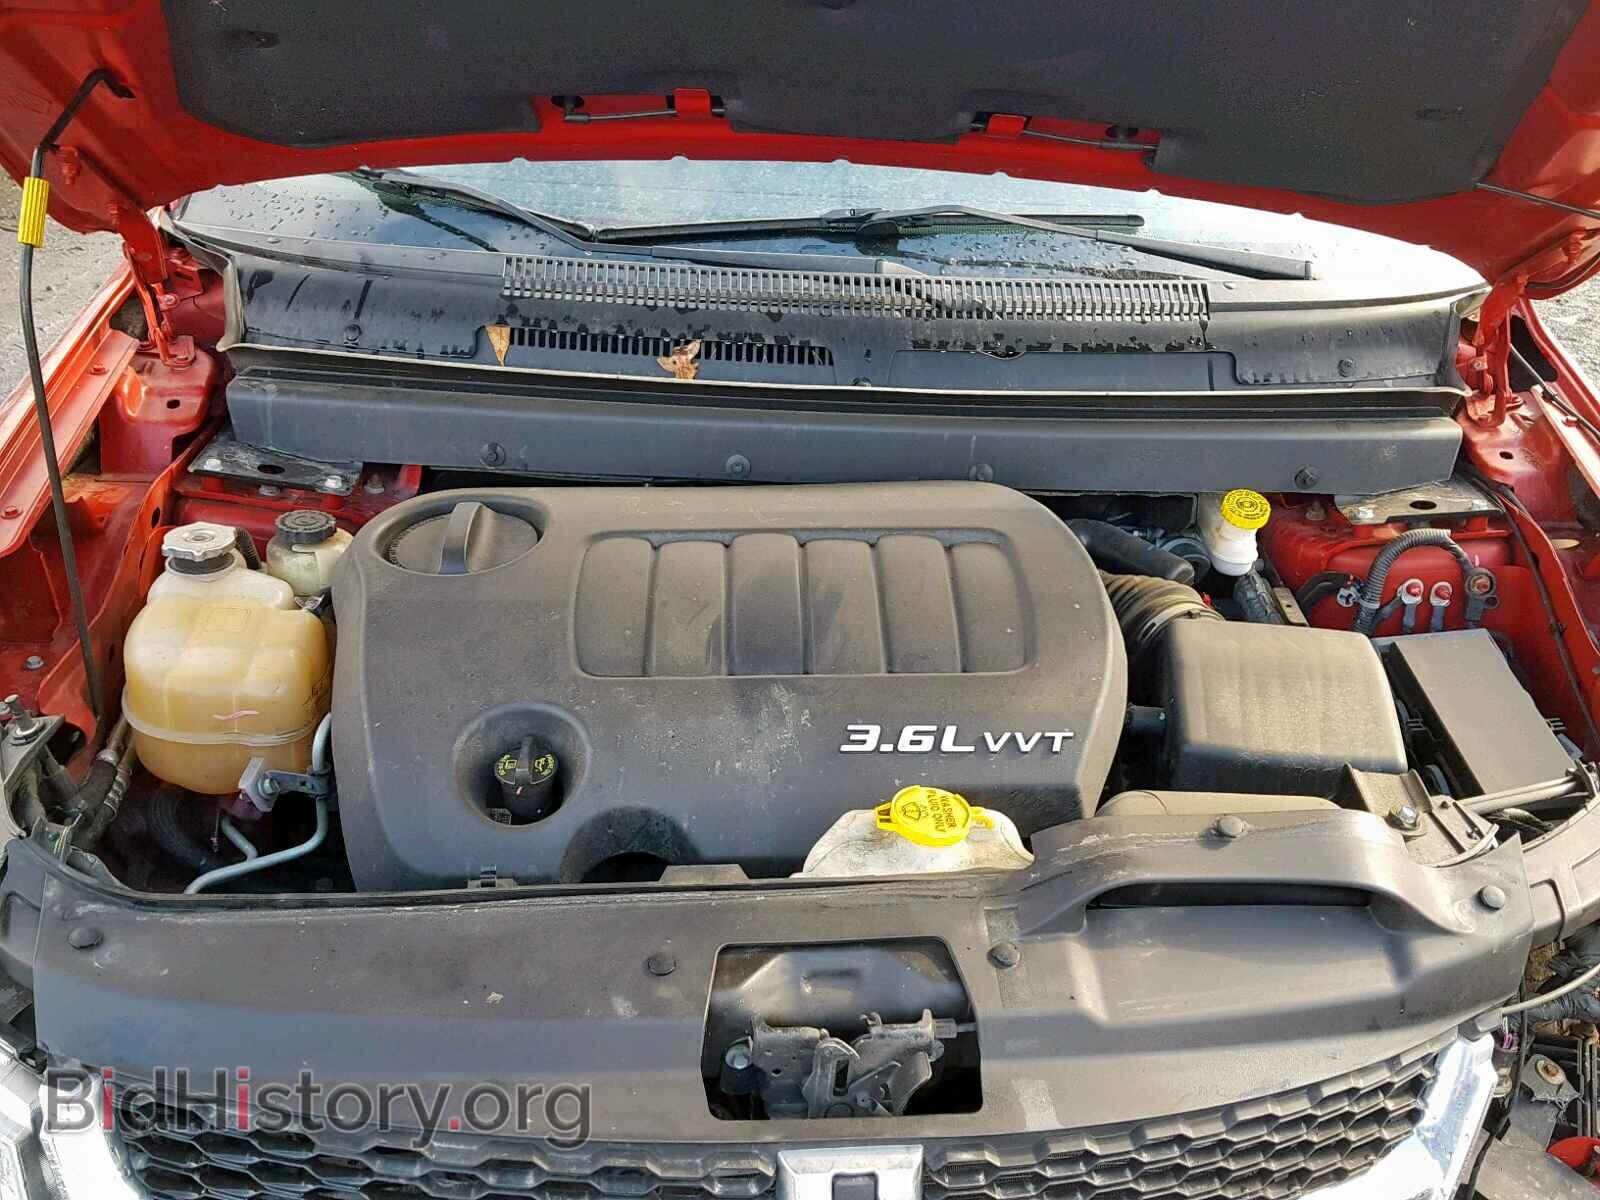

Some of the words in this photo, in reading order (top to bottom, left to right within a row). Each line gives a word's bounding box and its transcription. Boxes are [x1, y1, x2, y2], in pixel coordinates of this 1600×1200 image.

[840, 724, 976, 753] 3.6L
[983, 731, 1075, 753] VVT
[926, 790, 941, 812] FLUID
[940, 795, 957, 828] WASHER
[932, 812, 946, 833] ONLY
